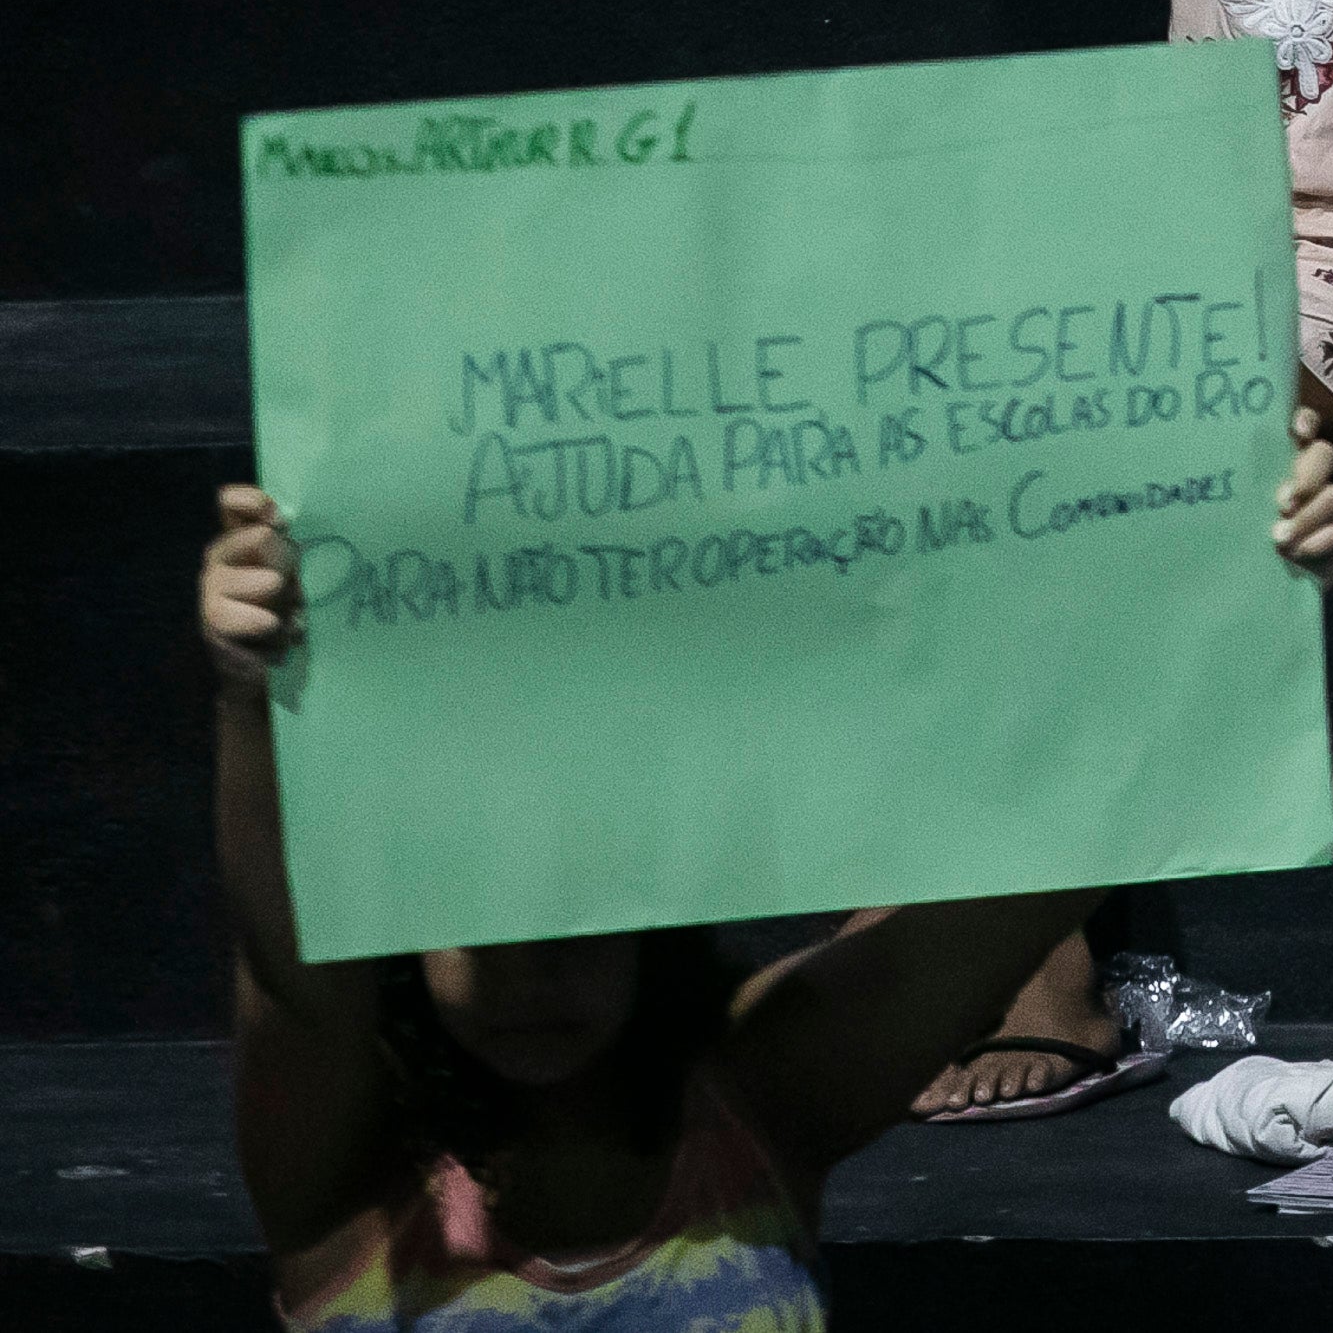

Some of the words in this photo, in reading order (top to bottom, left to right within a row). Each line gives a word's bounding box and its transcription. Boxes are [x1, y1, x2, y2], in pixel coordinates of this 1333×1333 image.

[854, 268, 1268, 407] PRESENTE!
[463, 431, 702, 525] AJUDA
[724, 410, 861, 493] PARA
[878, 407, 927, 465] AS
[946, 386, 1111, 455] ESCOLAS
[1126, 384, 1183, 428] DO
